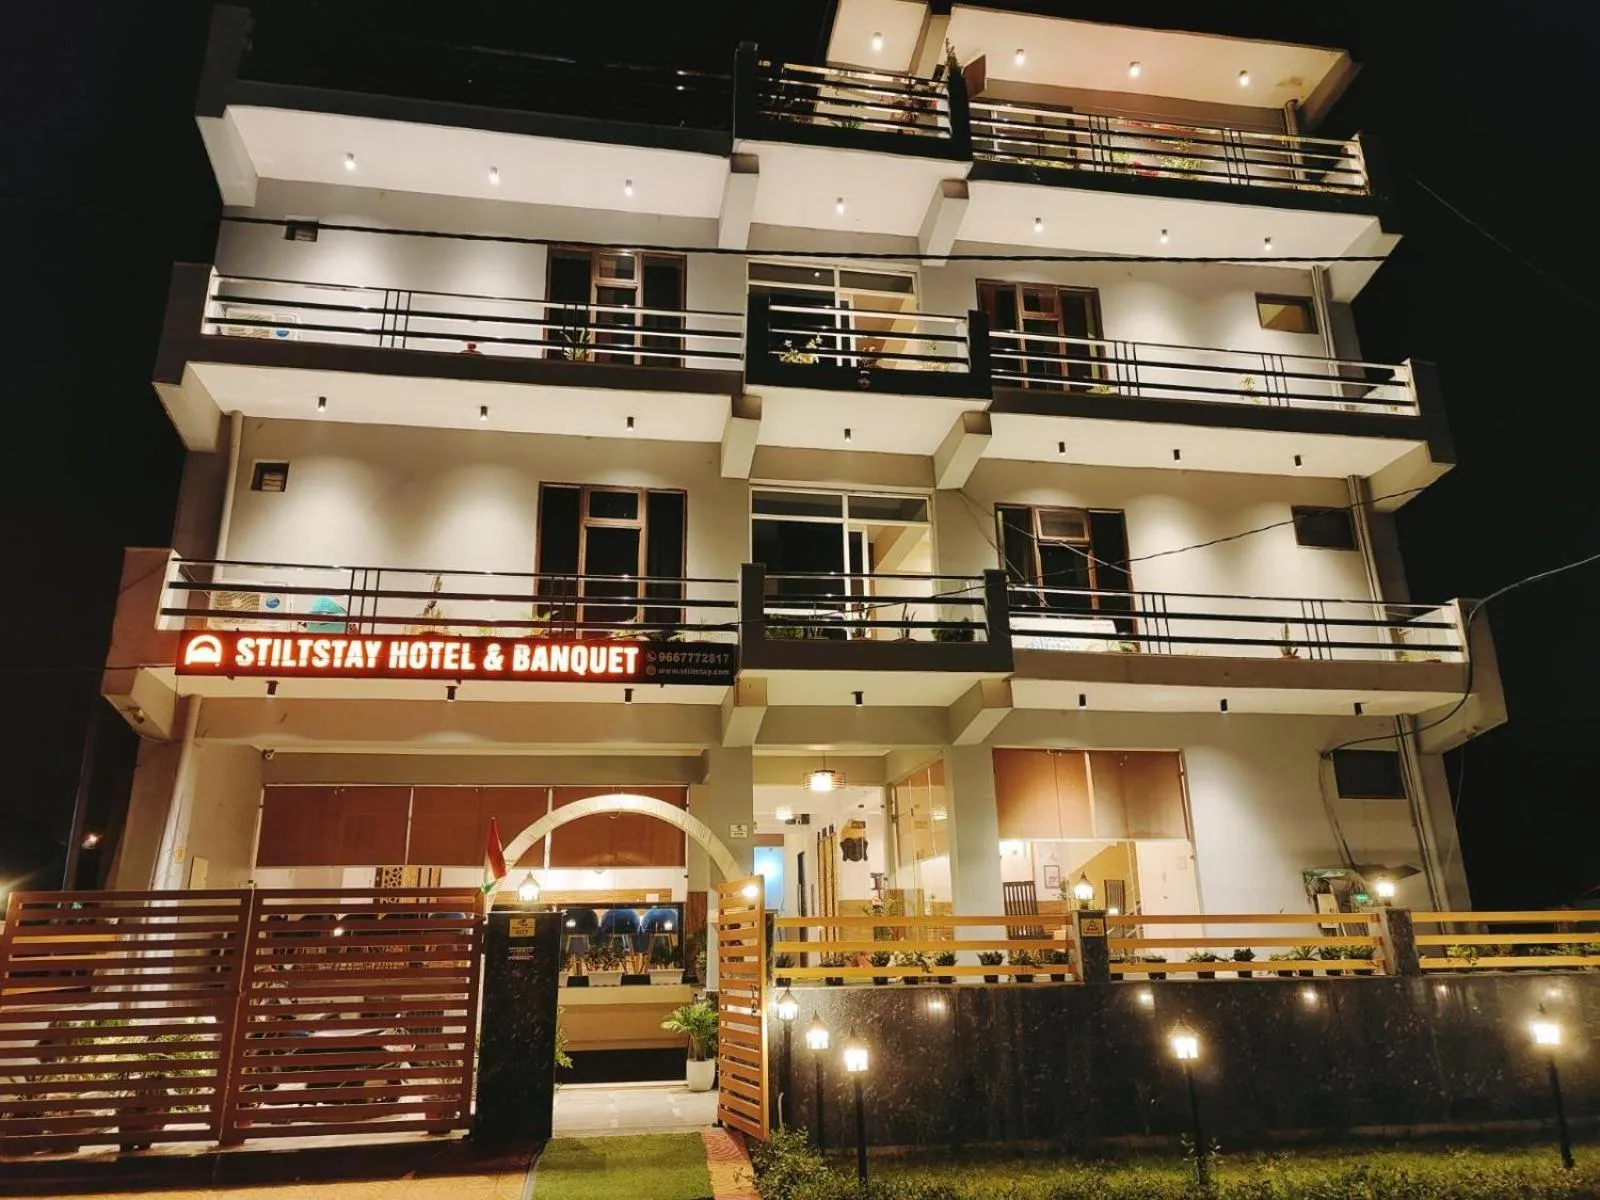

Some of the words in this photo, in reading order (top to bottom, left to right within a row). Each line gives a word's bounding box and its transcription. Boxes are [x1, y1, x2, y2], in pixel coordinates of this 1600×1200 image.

[235, 637, 382, 669] STILTSTAY
[388, 641, 475, 671] HOTEL
[483, 643, 504, 671] &
[512, 644, 639, 675] BANQUET
[658, 651, 730, 664] 9667772817
